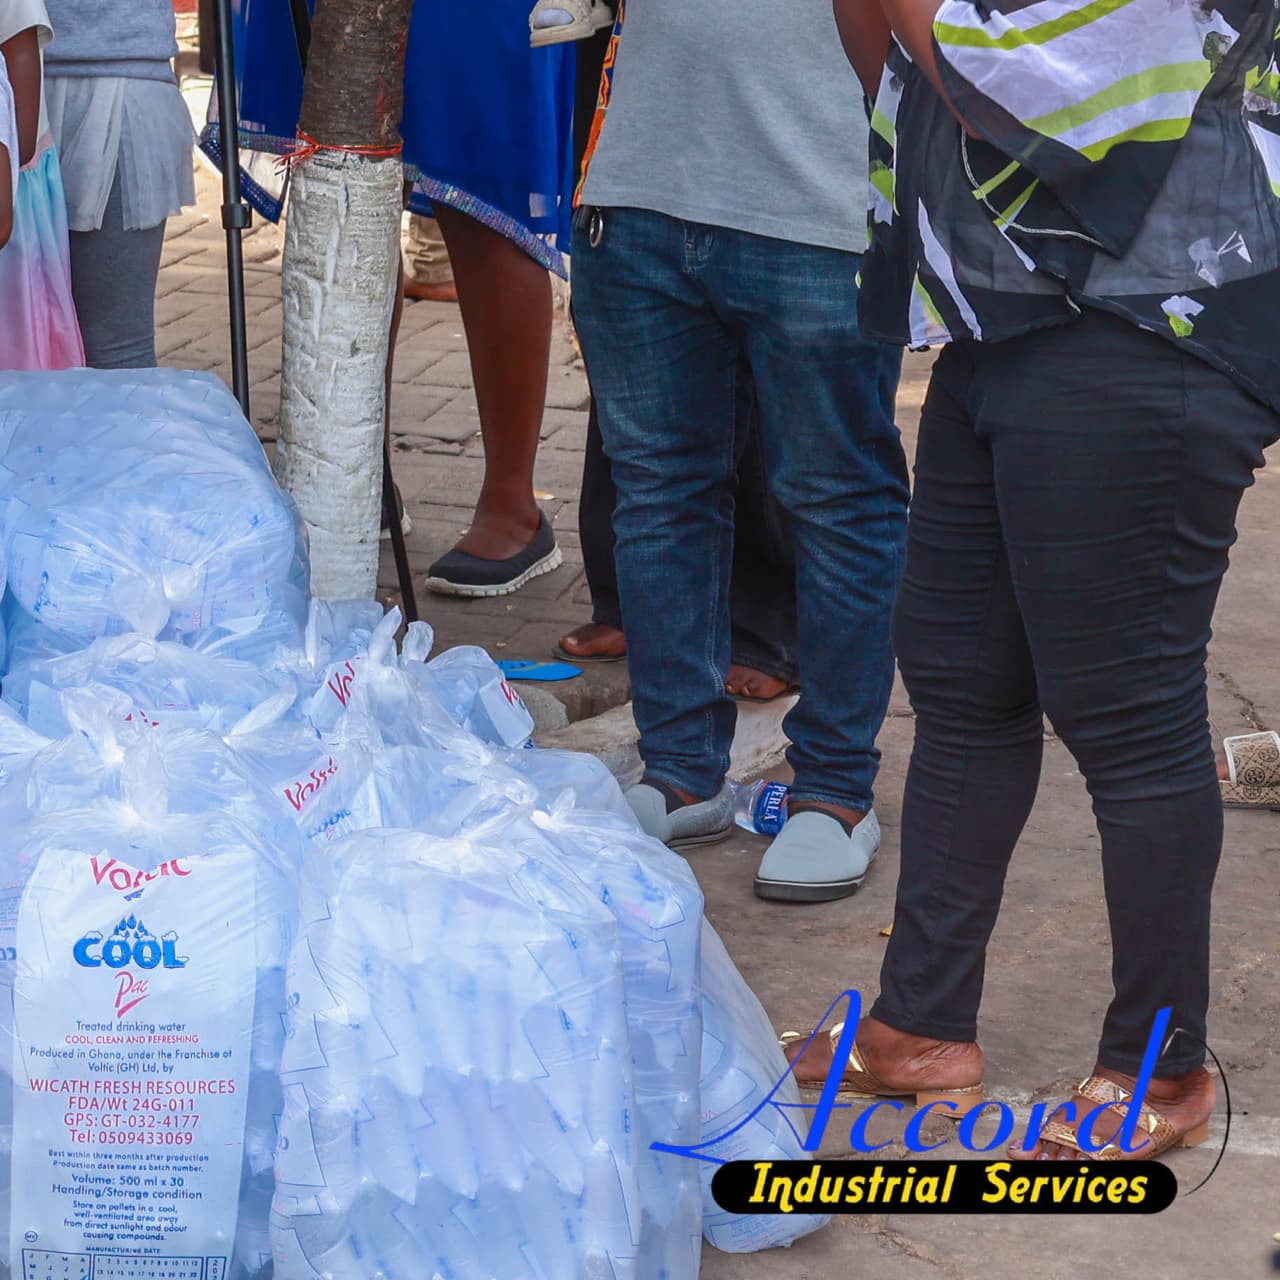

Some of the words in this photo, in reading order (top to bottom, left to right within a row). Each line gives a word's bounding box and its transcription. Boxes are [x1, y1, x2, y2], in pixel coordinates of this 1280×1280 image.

[763, 784, 788, 822] PERLA
[72, 930, 190, 970] COOL
[114, 970, 151, 1018] Pac
[76, 1020, 113, 1032] Treated
[116, 1020, 156, 1033] drinking
[158, 1022, 187, 1032] water
[65, 1034, 94, 1045] COOL,
[95, 1035, 124, 1045] CLEAN
[126, 1035, 146, 1045] AND
[30, 1046, 75, 1060] Produced
[77, 1048, 86, 1059] in
[88, 1048, 125, 1061] Ghana,
[127, 1048, 156, 1060] under
[157, 1048, 172, 1060] the
[175, 1048, 221, 1060] Franchise
[88, 1062, 114, 1073] Voltic
[116, 1062, 140, 1074] (GH)
[142, 1063, 160, 1075] Ltd,
[162, 1063, 174, 1075] by
[29, 1078, 90, 1094] WICATH
[94, 1079, 142, 1095] FRESH
[145, 1079, 237, 1095] RESOURCES
[68, 1095, 128, 1112] FDA/Wt
[132, 1097, 195, 1112] 24G-011
[64, 1112, 98, 1127] GPS:
[101, 1114, 200, 1129] GT-032-4177
[69, 1128, 96, 1144] Tel:
[98, 1131, 194, 1145] 0509433069
[66, 1149, 91, 1159] within
[92, 1150, 113, 1160] three
[114, 1152, 144, 1161] months
[166, 1153, 209, 1163] production
[52, 1159, 96, 1170] Production
[97, 1161, 114, 1171] date
[148, 1163, 171, 1172] batch
[71, 1173, 116, 1185] Volume:
[119, 1175, 141, 1186] 500
[143, 1175, 158, 1186] ml
[169, 1176, 185, 1187] 30
[52, 1183, 149, 1200] Handling/Storage
[152, 1189, 203, 1200] condition
[110, 1220, 144, 1233] sunlight
[83, 1231, 114, 1241] causing
